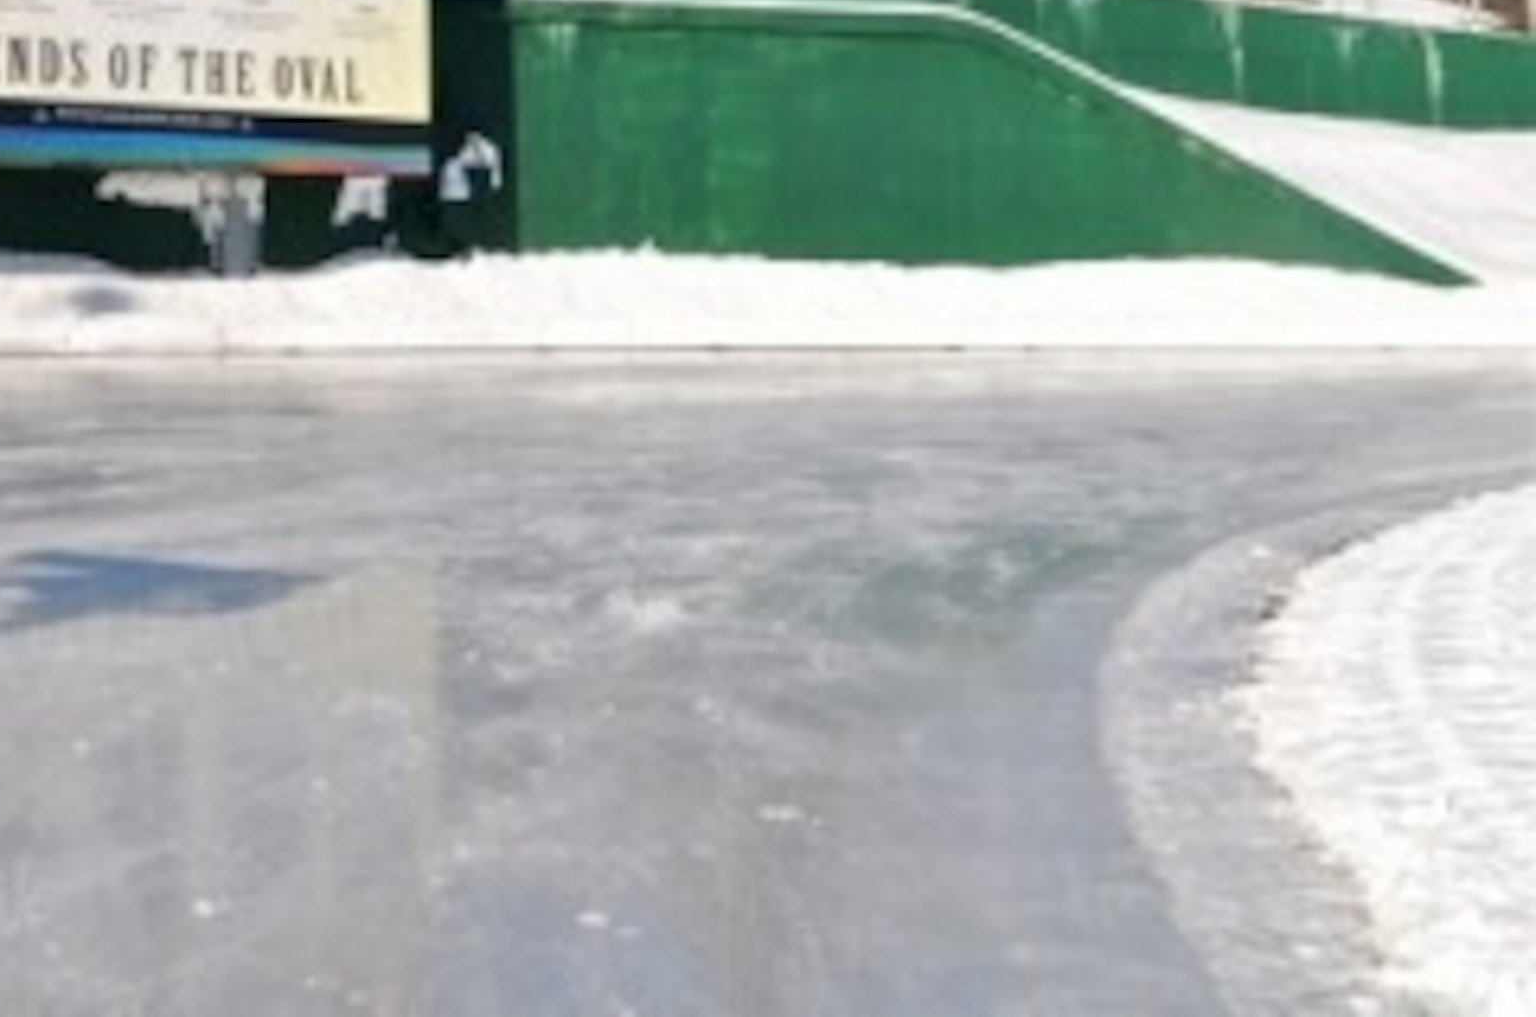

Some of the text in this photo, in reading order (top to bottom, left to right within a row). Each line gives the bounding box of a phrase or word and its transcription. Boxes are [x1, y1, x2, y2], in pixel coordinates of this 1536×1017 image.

[107, 44, 158, 90] OF
[178, 47, 258, 98] THE
[274, 55, 365, 103] OVAL
